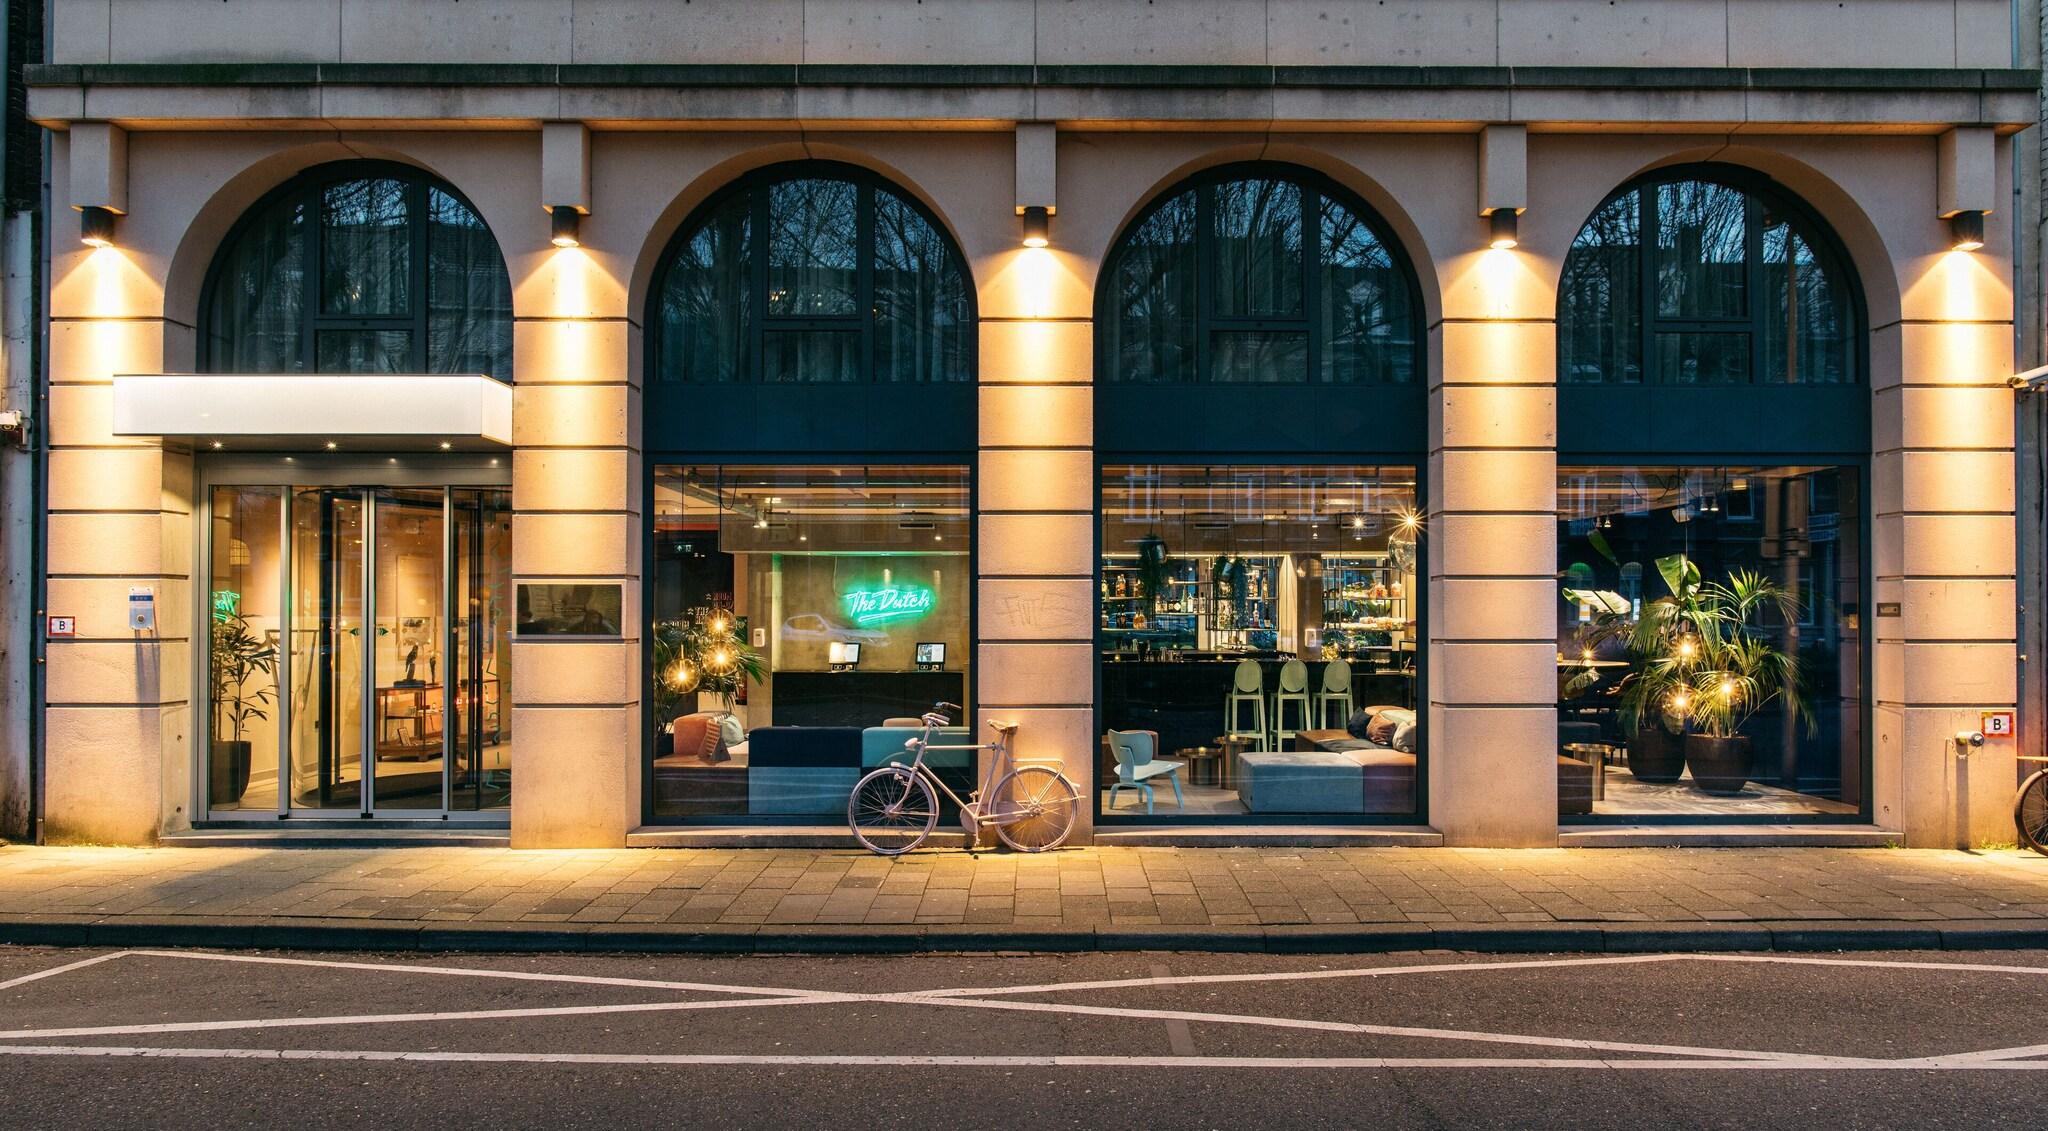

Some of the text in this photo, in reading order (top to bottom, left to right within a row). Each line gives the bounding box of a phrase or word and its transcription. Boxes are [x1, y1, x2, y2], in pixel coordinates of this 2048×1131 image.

[846, 588, 930, 617] The Dutch
[59, 620, 66, 631] B
[1993, 718, 2002, 731] B
